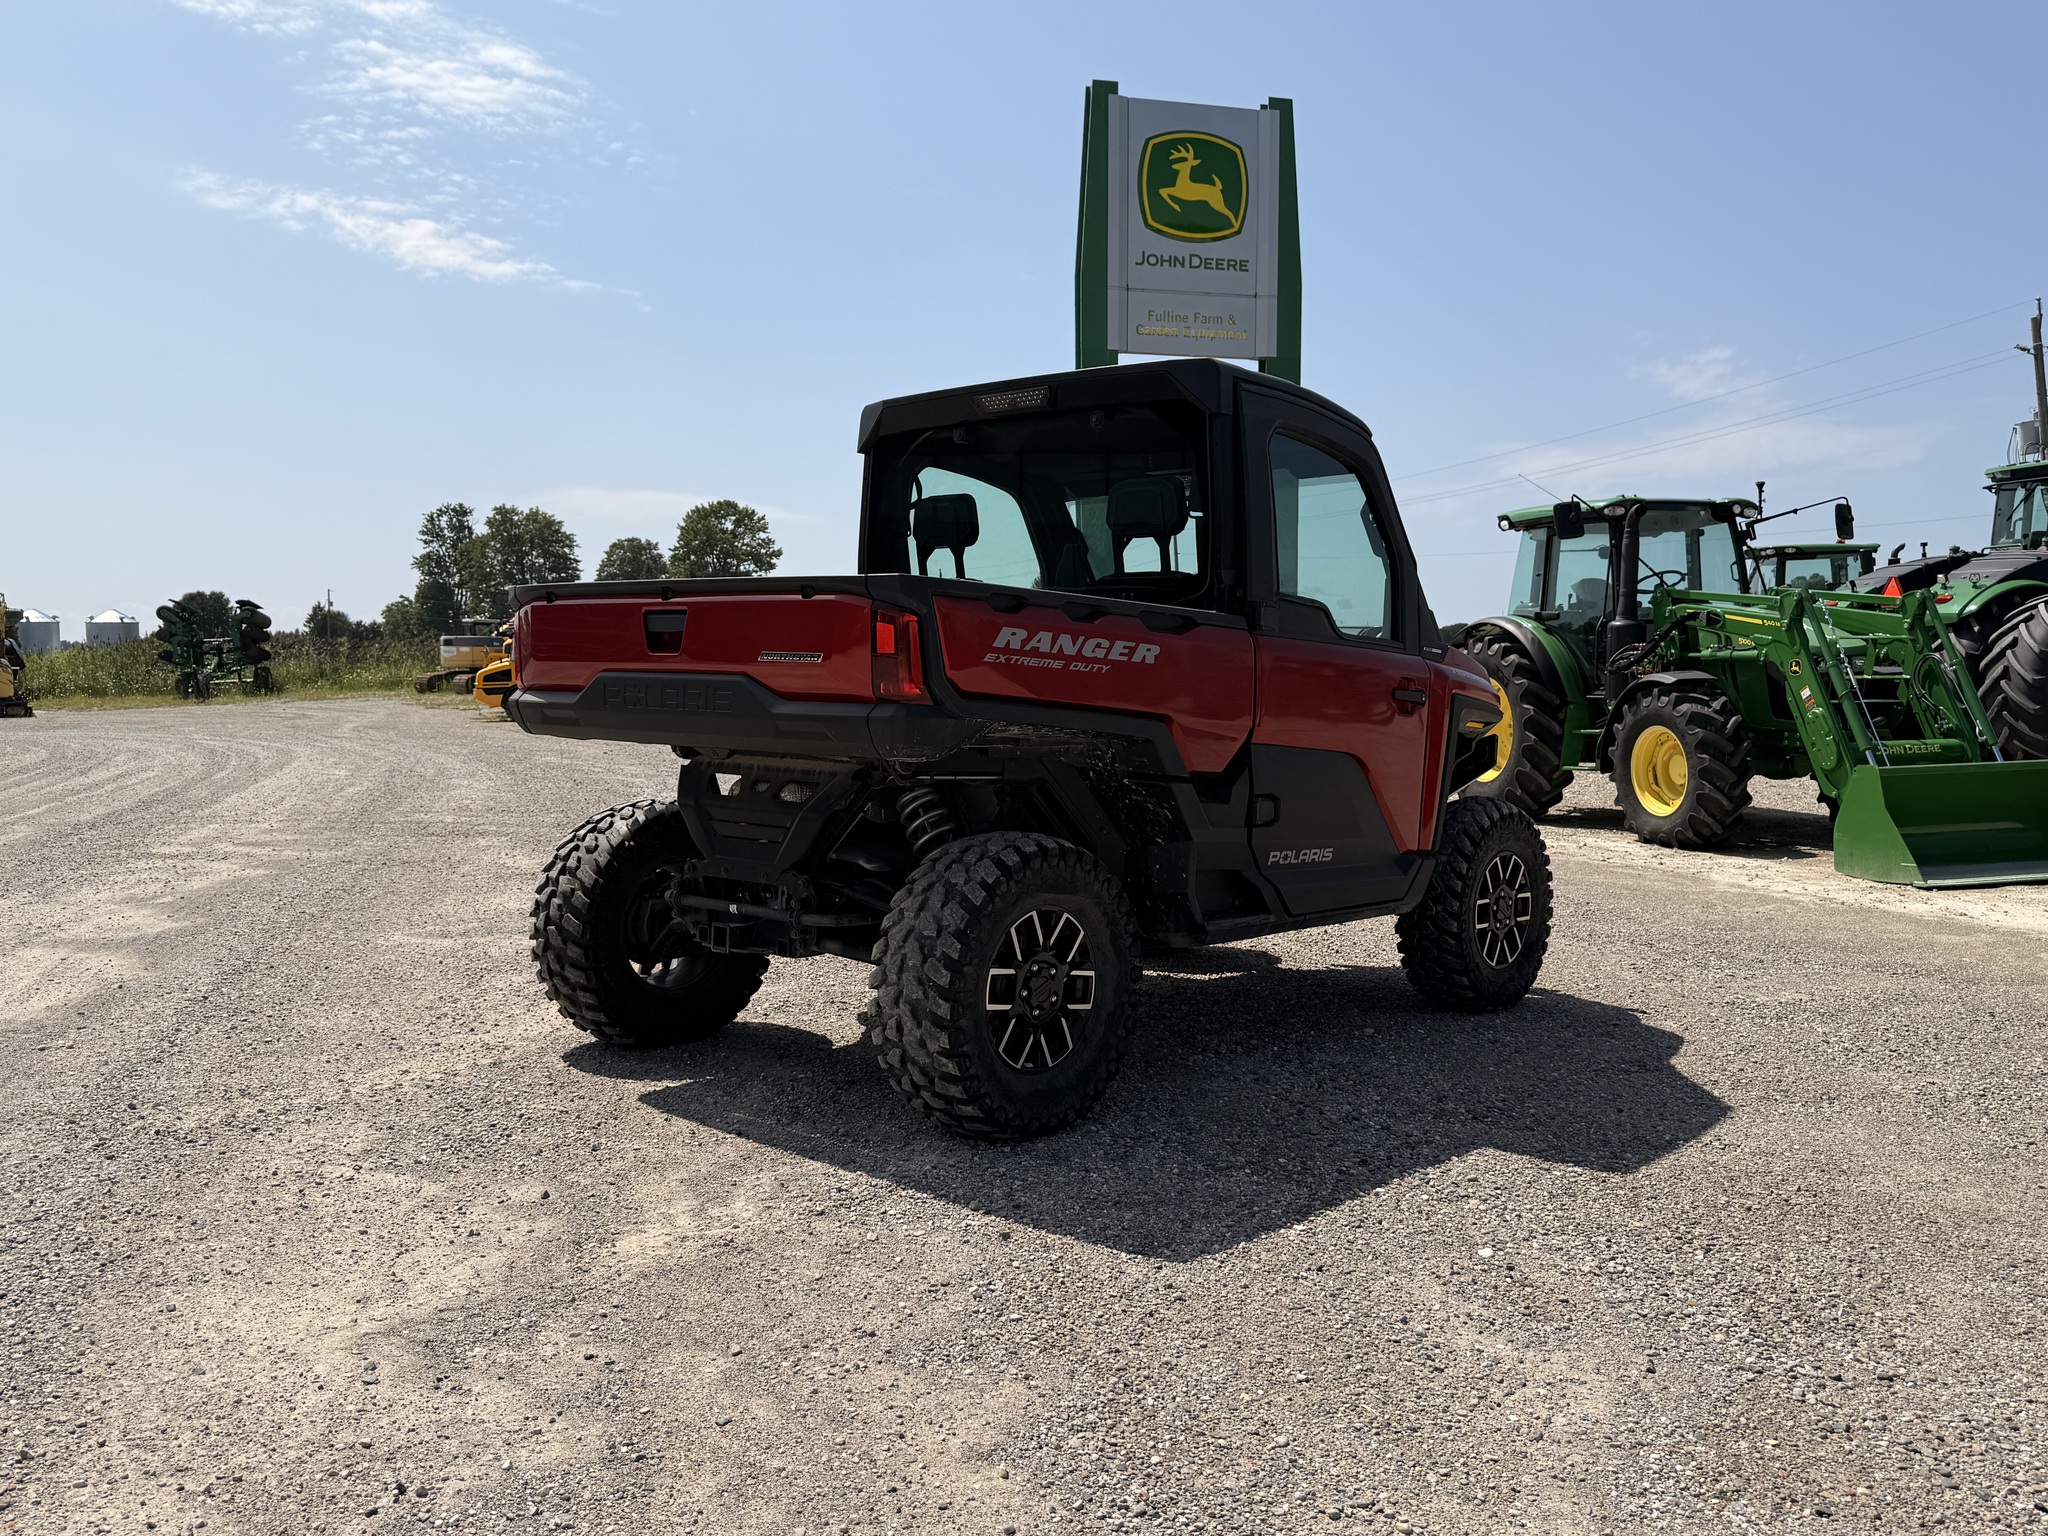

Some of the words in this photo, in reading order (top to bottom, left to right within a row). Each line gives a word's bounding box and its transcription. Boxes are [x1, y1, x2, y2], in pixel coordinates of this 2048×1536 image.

[1135, 250, 1185, 268] JOHN
[1189, 254, 1250, 272] DEERE
[1147, 310, 1189, 323] Fulline
[1193, 312, 1223, 325] Farm
[1227, 314, 1237, 325] &
[1135, 324, 1178, 337] Garden
[1183, 326, 1247, 341] Equipment
[992, 626, 1161, 664] RANGER
[983, 653, 1065, 669] EXTREME
[1069, 662, 1112, 673] DUTY
[603, 683, 733, 712] POLARIS
[1905, 744, 1941, 754] DEERE
[1267, 848, 1334, 865] POLARIS
